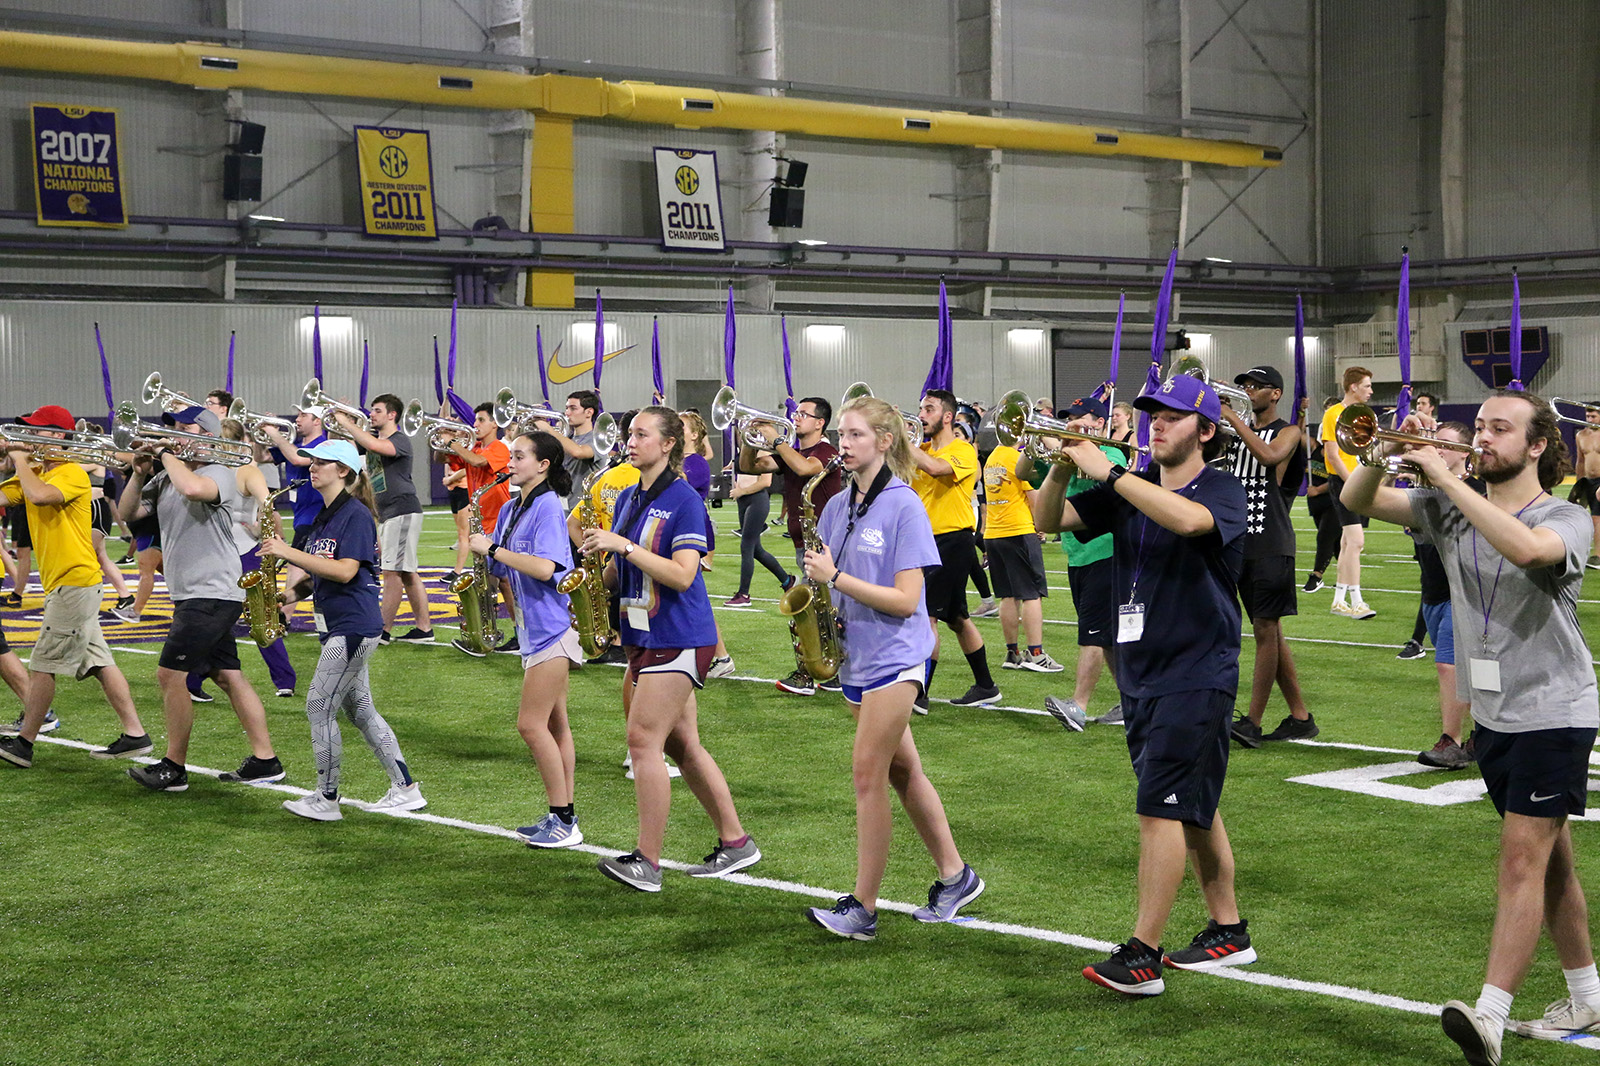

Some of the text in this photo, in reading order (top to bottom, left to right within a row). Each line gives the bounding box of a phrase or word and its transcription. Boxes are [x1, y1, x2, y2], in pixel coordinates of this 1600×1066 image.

[65, 107, 85, 116] LSU
[40, 130, 111, 163] 2007
[678, 150, 693, 158] LSU
[43, 163, 114, 181] NATIONAL
[44, 178, 115, 193] CHAMPIONS
[366, 181, 427, 192] WESTERN DIVISION
[371, 190, 426, 221] 2011
[666, 201, 715, 230] 2011
[375, 220, 426, 232] CHAMPIONS
[668, 230, 719, 241] CHAMPIONS
